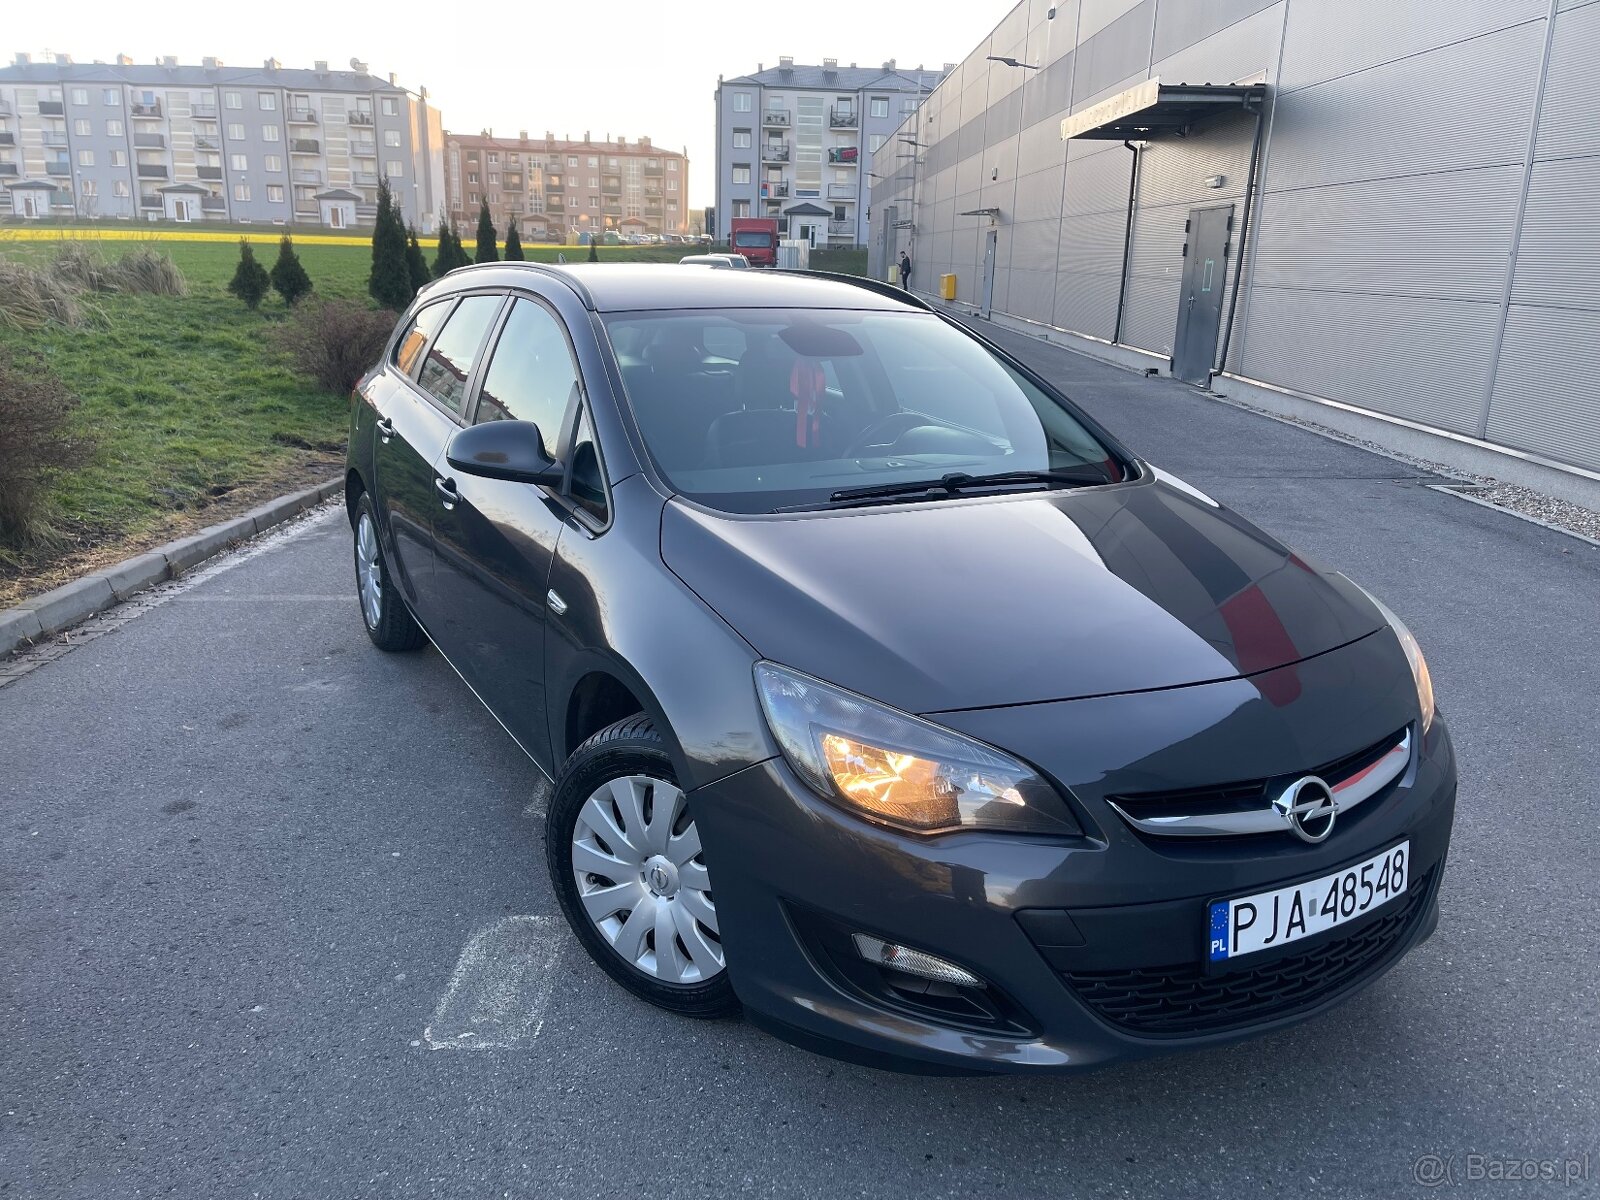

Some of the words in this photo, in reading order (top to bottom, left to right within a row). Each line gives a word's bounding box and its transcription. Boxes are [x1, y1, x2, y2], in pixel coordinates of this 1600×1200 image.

[1232, 889, 1306, 952] PJA
[1319, 849, 1405, 922] 48548
[1211, 938, 1227, 954] PL
